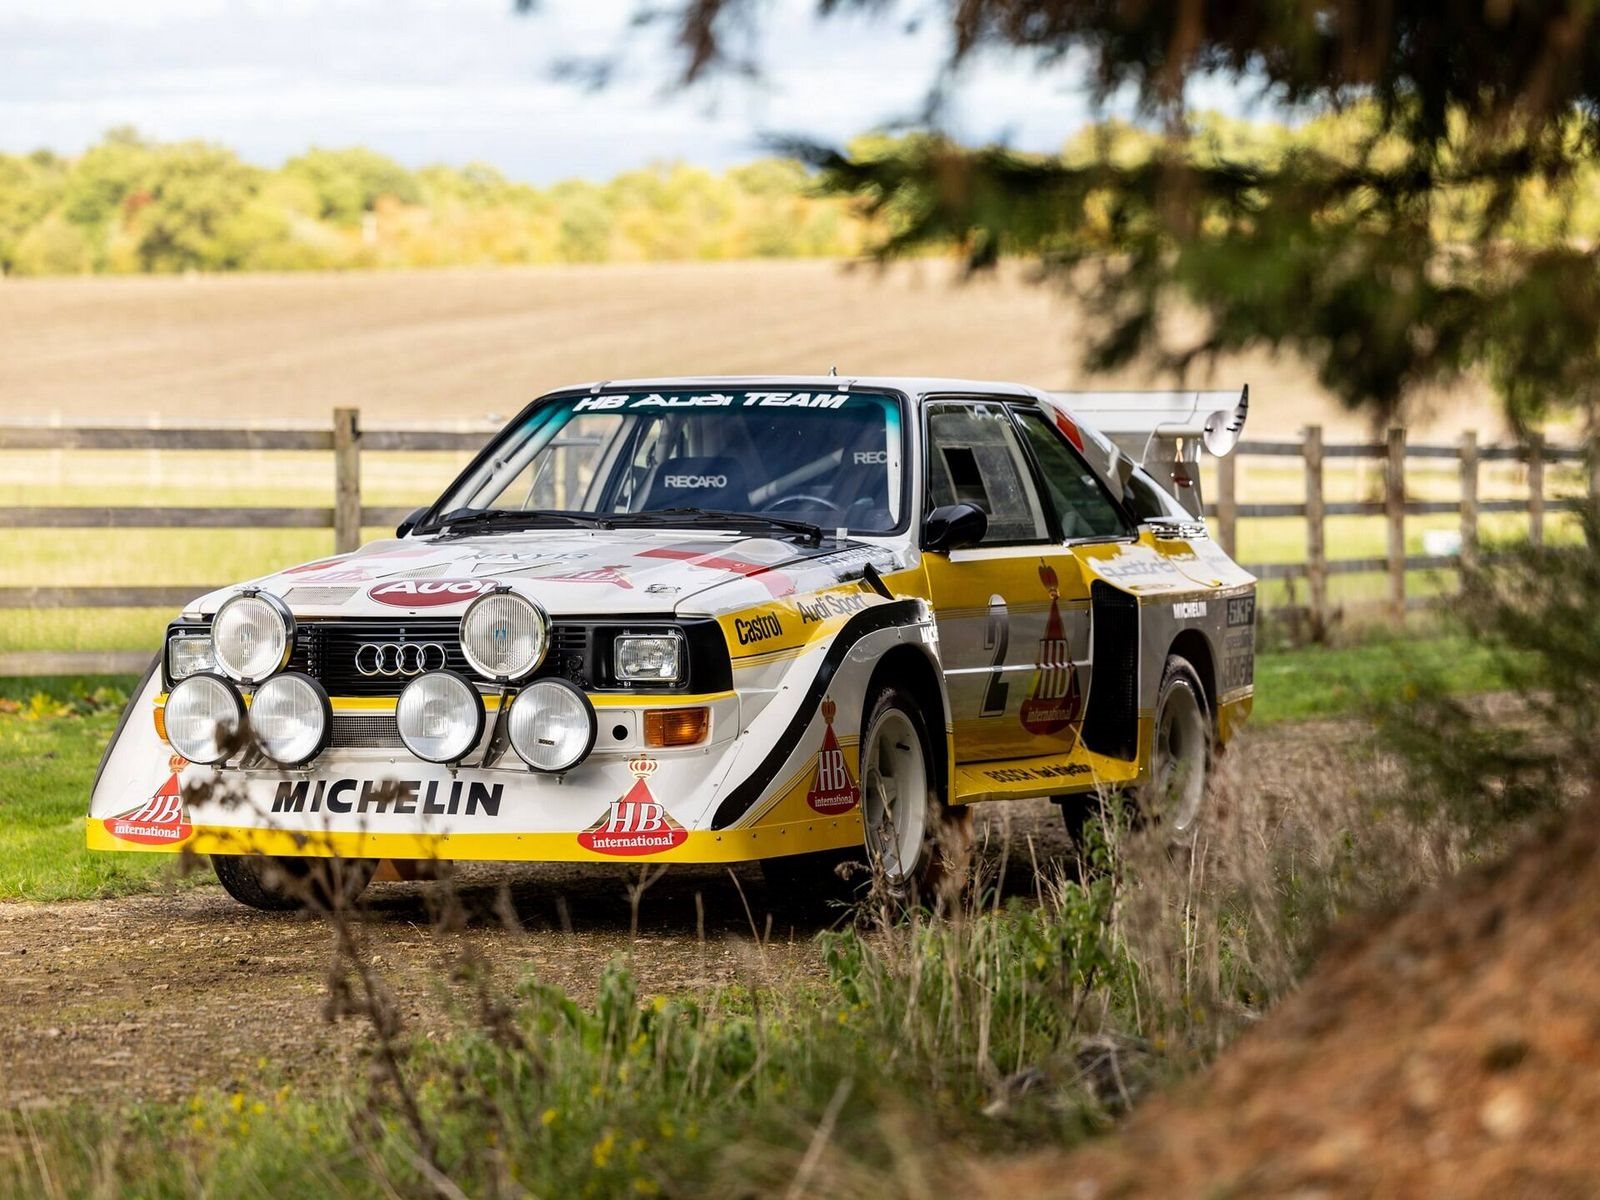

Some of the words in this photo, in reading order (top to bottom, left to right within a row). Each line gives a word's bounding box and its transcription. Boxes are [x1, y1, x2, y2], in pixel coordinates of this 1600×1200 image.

[573, 394, 630, 412] HB
[743, 392, 849, 409] TEAM
[664, 475, 728, 488] RECARO
[796, 595, 830, 624] Audi
[826, 591, 870, 616] Sport
[1228, 598, 1254, 625] SKF
[734, 612, 783, 646] Castrol
[979, 593, 1010, 719] 2
[818, 749, 847, 791] HB
[127, 795, 184, 824] HB
[270, 778, 505, 817] MICHELIN
[814, 791, 855, 808] international
[114, 824, 181, 839] international
[605, 801, 665, 833] HB
[592, 832, 674, 849] international
